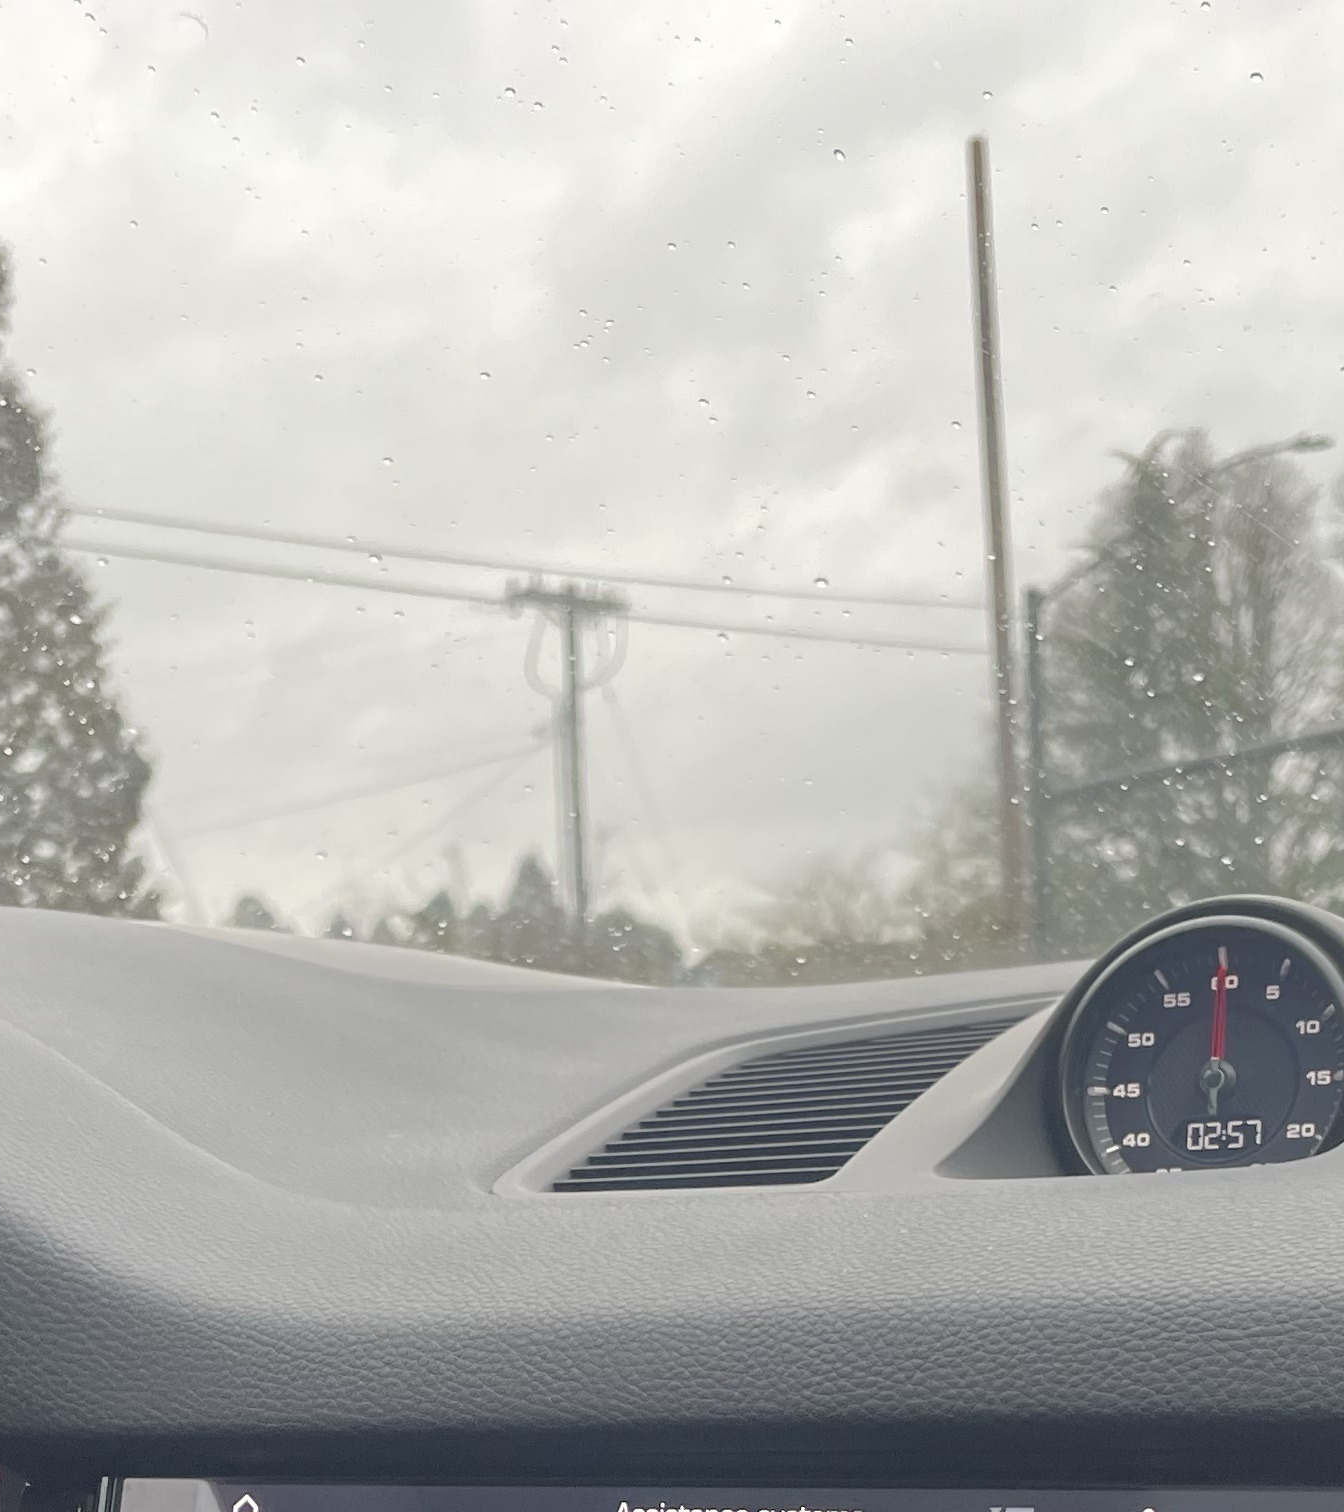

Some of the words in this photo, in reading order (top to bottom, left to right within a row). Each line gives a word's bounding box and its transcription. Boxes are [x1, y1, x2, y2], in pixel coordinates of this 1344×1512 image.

[1162, 991, 1192, 1009] 55
[1265, 984, 1281, 1000] 5
[1295, 1019, 1321, 1036] 10
[1127, 1032, 1156, 1048] 50
[1306, 1070, 1332, 1086] 15
[1112, 1083, 1141, 1099] 45
[1186, 1119, 1264, 1151] 02:57
[1286, 1122, 1316, 1139] 20
[1122, 1133, 1151, 1148] 40
